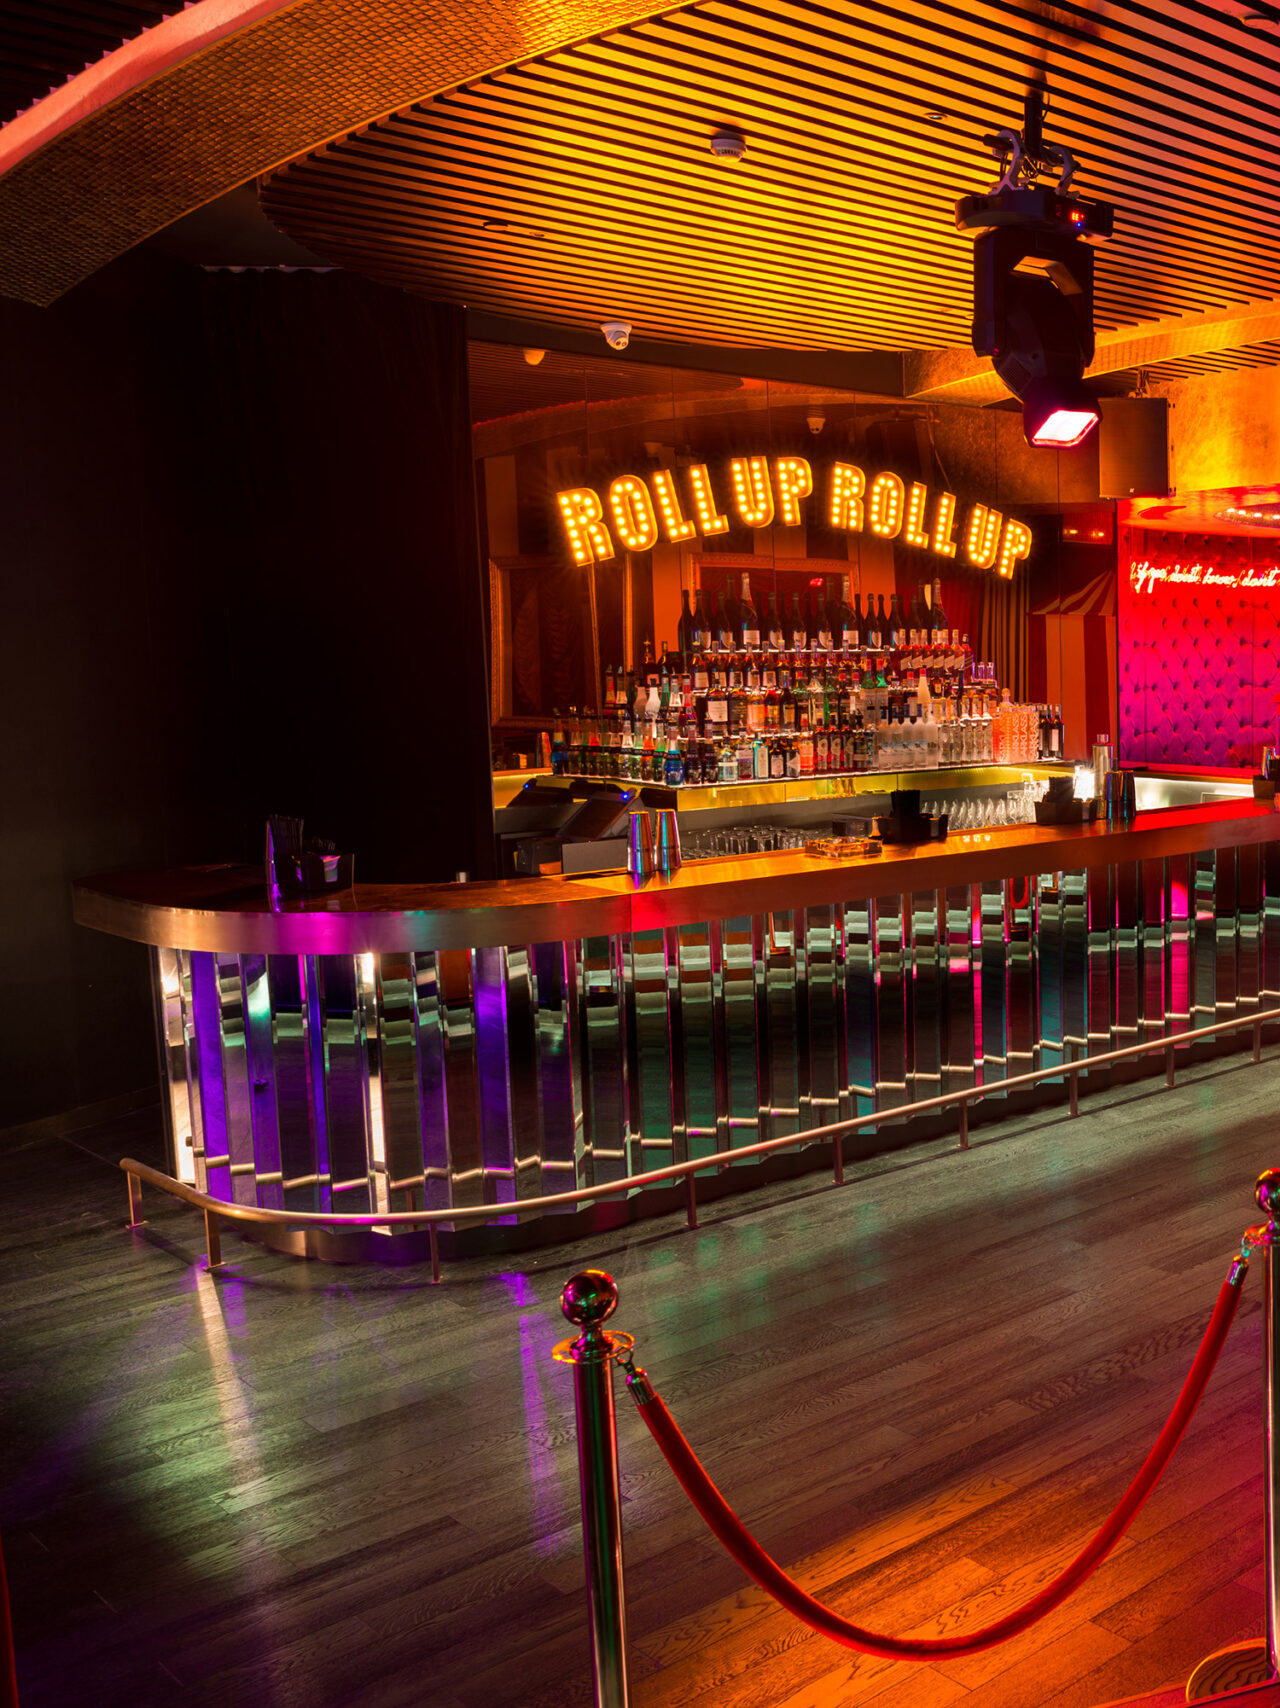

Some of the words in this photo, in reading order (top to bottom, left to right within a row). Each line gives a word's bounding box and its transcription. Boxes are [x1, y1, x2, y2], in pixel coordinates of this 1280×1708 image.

[557, 464, 729, 567] ROLL
[731, 456, 813, 528] UP
[831, 461, 957, 559] ROLL
[968, 502, 1032, 579] UP
